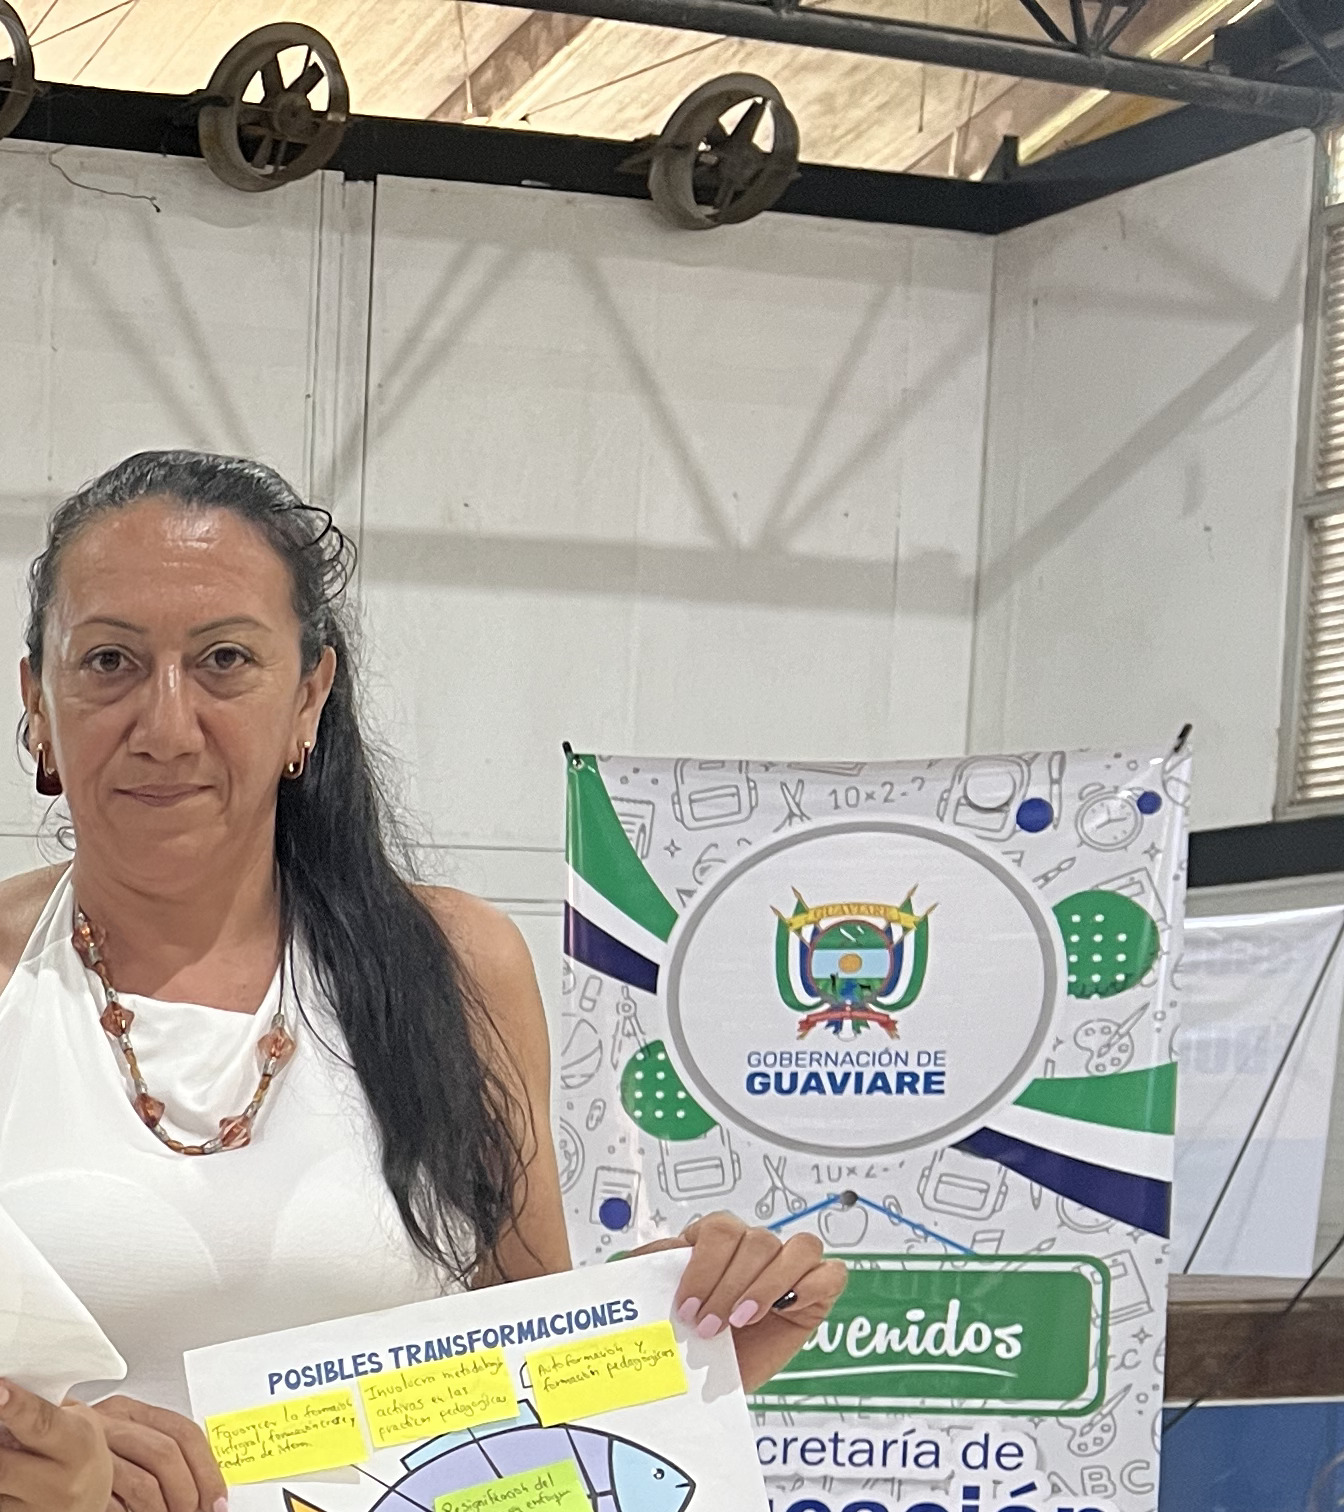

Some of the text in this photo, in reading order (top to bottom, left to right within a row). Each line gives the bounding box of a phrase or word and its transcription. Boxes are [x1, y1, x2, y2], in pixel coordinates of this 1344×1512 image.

[747, 1047, 946, 1068] GOBERNACIÓN DE
[745, 1071, 946, 1096] GUAVIARE
[267, 1299, 639, 1395] POSIBLES TRANSFORMACIONES
[802, 1298, 1024, 1360] venidos
[961, 1432, 1024, 1471] de
